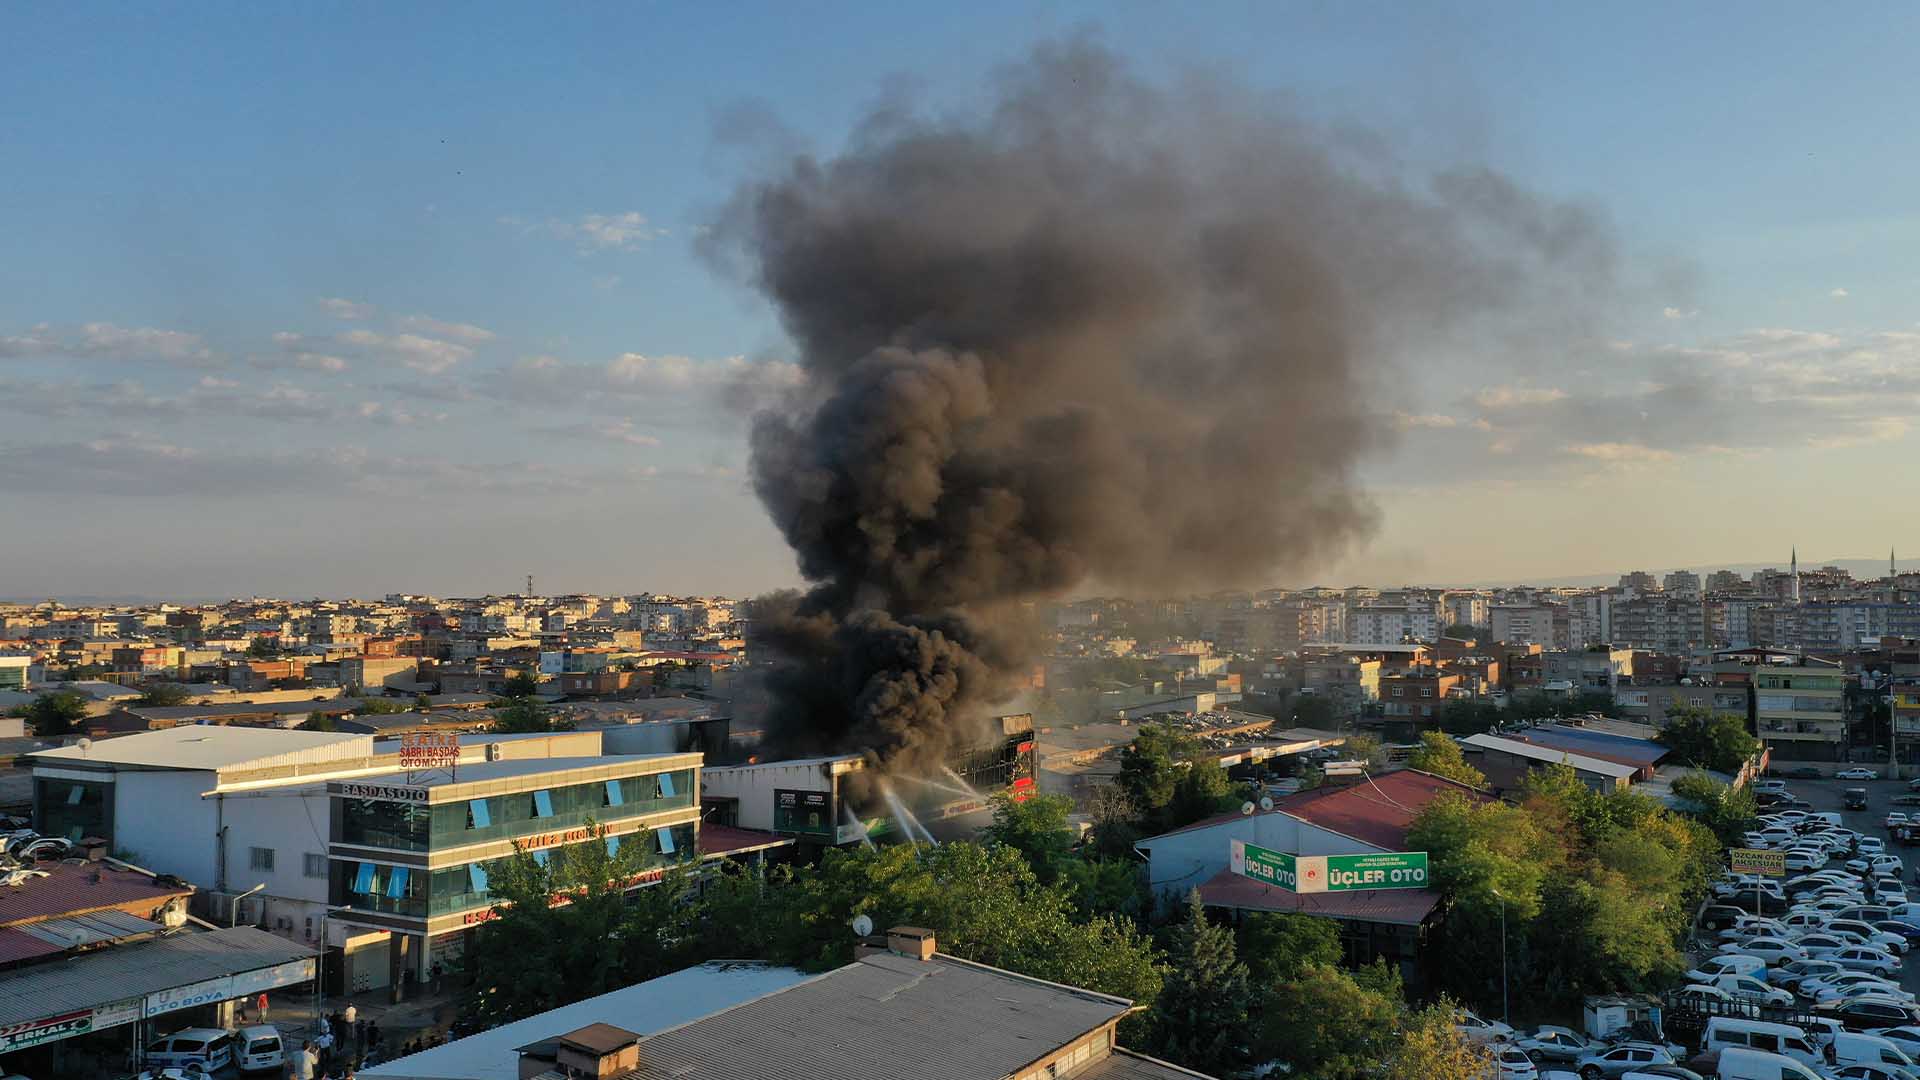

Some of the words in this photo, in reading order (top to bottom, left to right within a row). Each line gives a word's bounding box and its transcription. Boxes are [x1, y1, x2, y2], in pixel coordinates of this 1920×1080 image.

[398, 789, 426, 800] OTO
[1246, 856, 1274, 879] ÜÇLER
[1276, 869, 1295, 885] OTO
[1330, 869, 1385, 888] ÜÇLER
[1390, 868, 1425, 882] OTO
[149, 1001, 179, 1015] OTO
[183, 992, 223, 1005] BOYA
[15, 1023, 67, 1042] ERKAL
